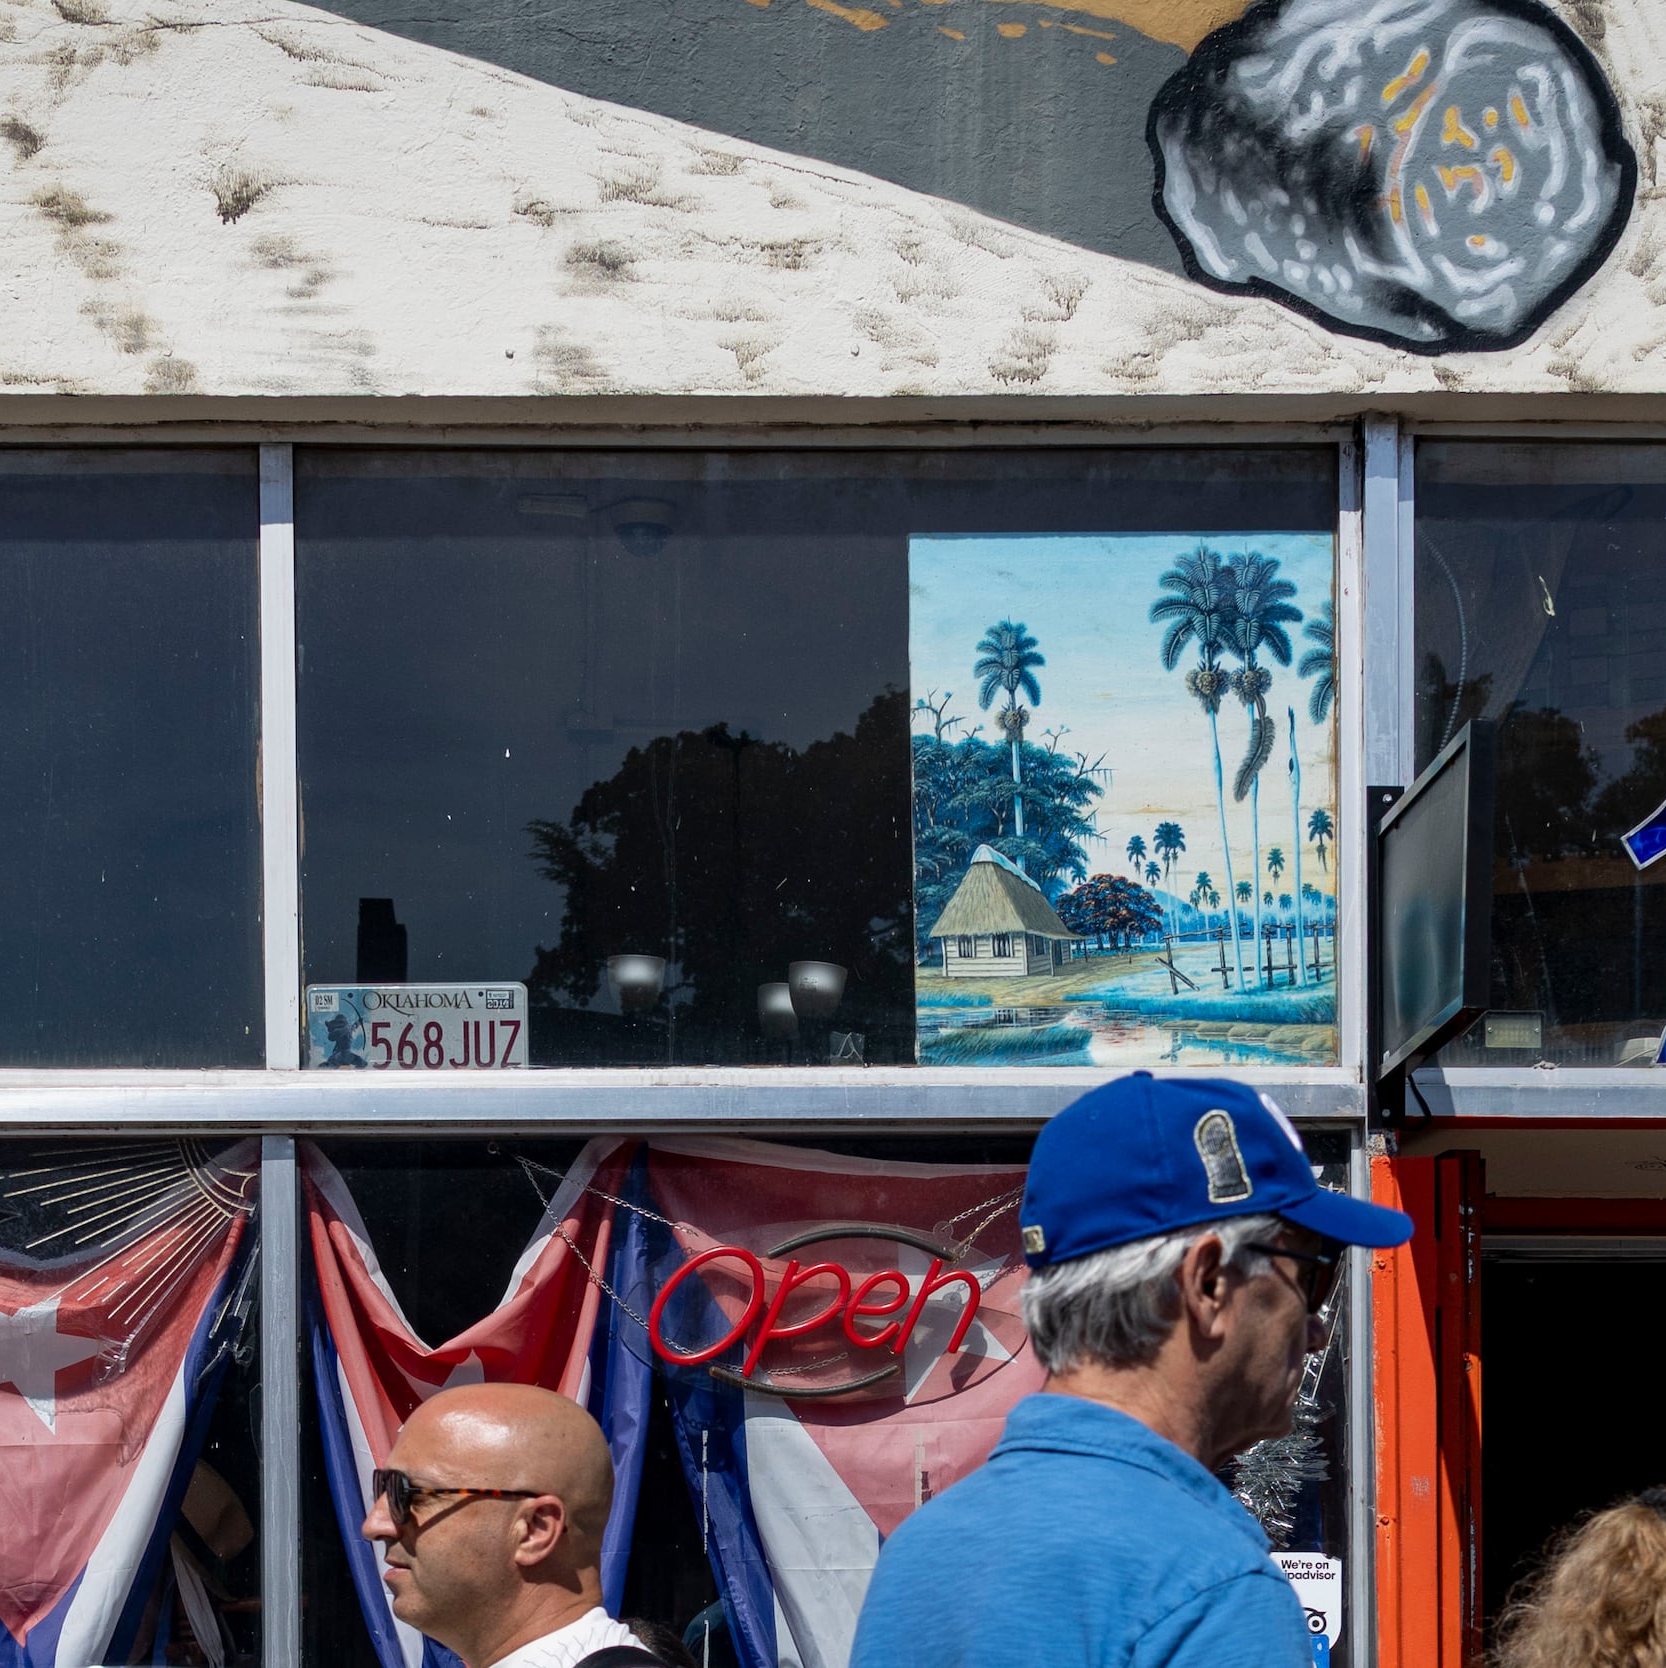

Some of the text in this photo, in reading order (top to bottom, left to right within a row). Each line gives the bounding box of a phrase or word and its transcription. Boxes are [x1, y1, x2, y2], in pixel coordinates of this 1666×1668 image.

[362, 990, 474, 1016] OKLAHOMA
[371, 1020, 522, 1069] 568 JUZ
[1315, 1561, 1329, 1570] on
